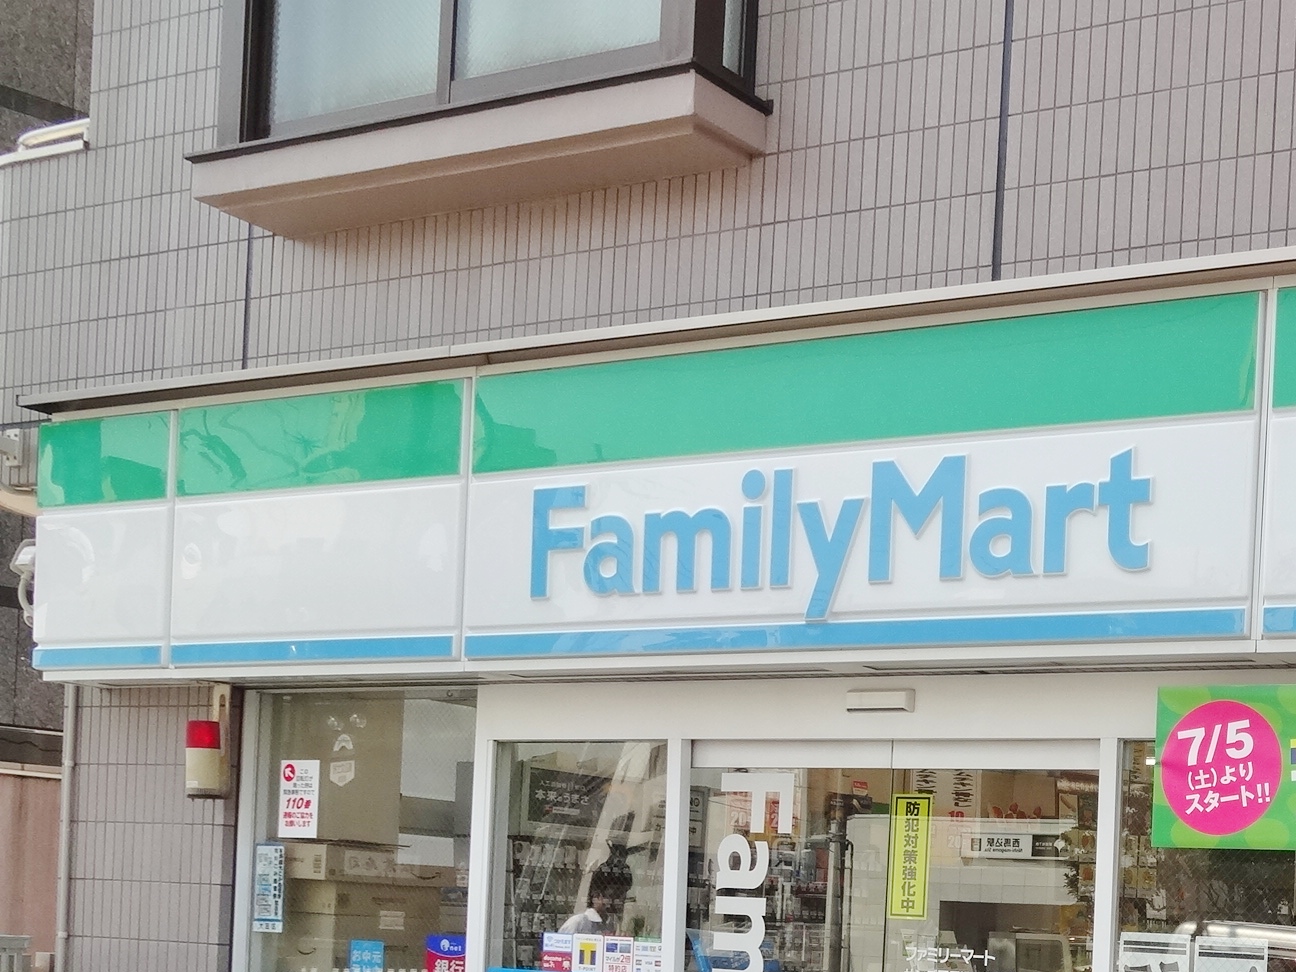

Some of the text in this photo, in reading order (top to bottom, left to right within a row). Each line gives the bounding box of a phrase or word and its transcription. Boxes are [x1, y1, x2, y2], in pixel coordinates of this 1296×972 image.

[529, 445, 1153, 622] FamilyMart
[1177, 719, 1254, 767] 7/5
[1187, 762, 1254, 790] (土)より
[286, 797, 312, 810] 110番
[1185, 783, 1271, 815] スタート!!
[900, 801, 920, 913] 防犯対策強化中
[905, 946, 996, 967] ファミリーマート
